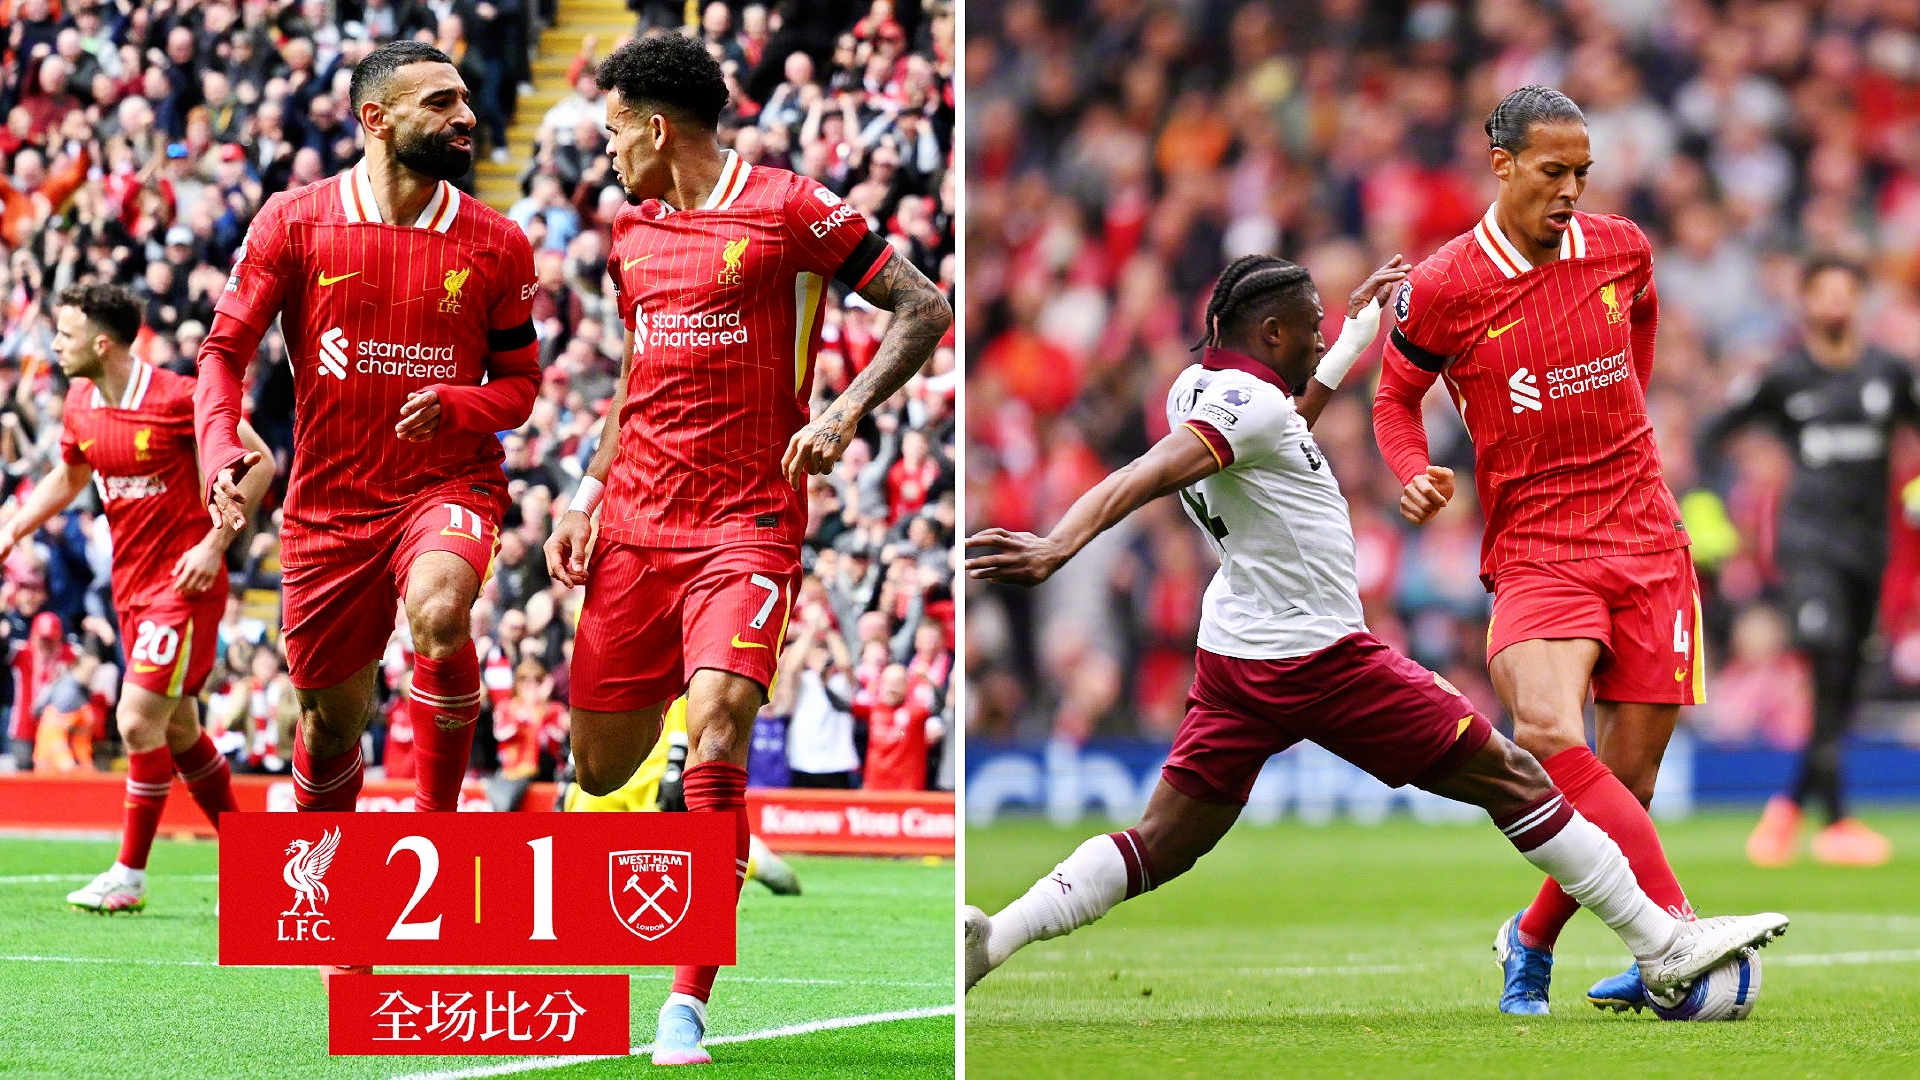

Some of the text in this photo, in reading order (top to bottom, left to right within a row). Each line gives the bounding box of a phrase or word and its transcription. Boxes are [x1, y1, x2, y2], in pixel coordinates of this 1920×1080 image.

[649, 326, 748, 347] chartered
[651, 310, 740, 329] standard
[355, 356, 457, 379] chartered
[357, 338, 454, 361] standard
[1545, 348, 1626, 385] standard
[1548, 362, 1629, 400] chartered
[443, 503, 482, 541] 11
[749, 572, 779, 630] 7
[131, 619, 178, 666] 20
[1673, 609, 1689, 661] 4
[761, 804, 843, 835] Know
[845, 806, 900, 837] You
